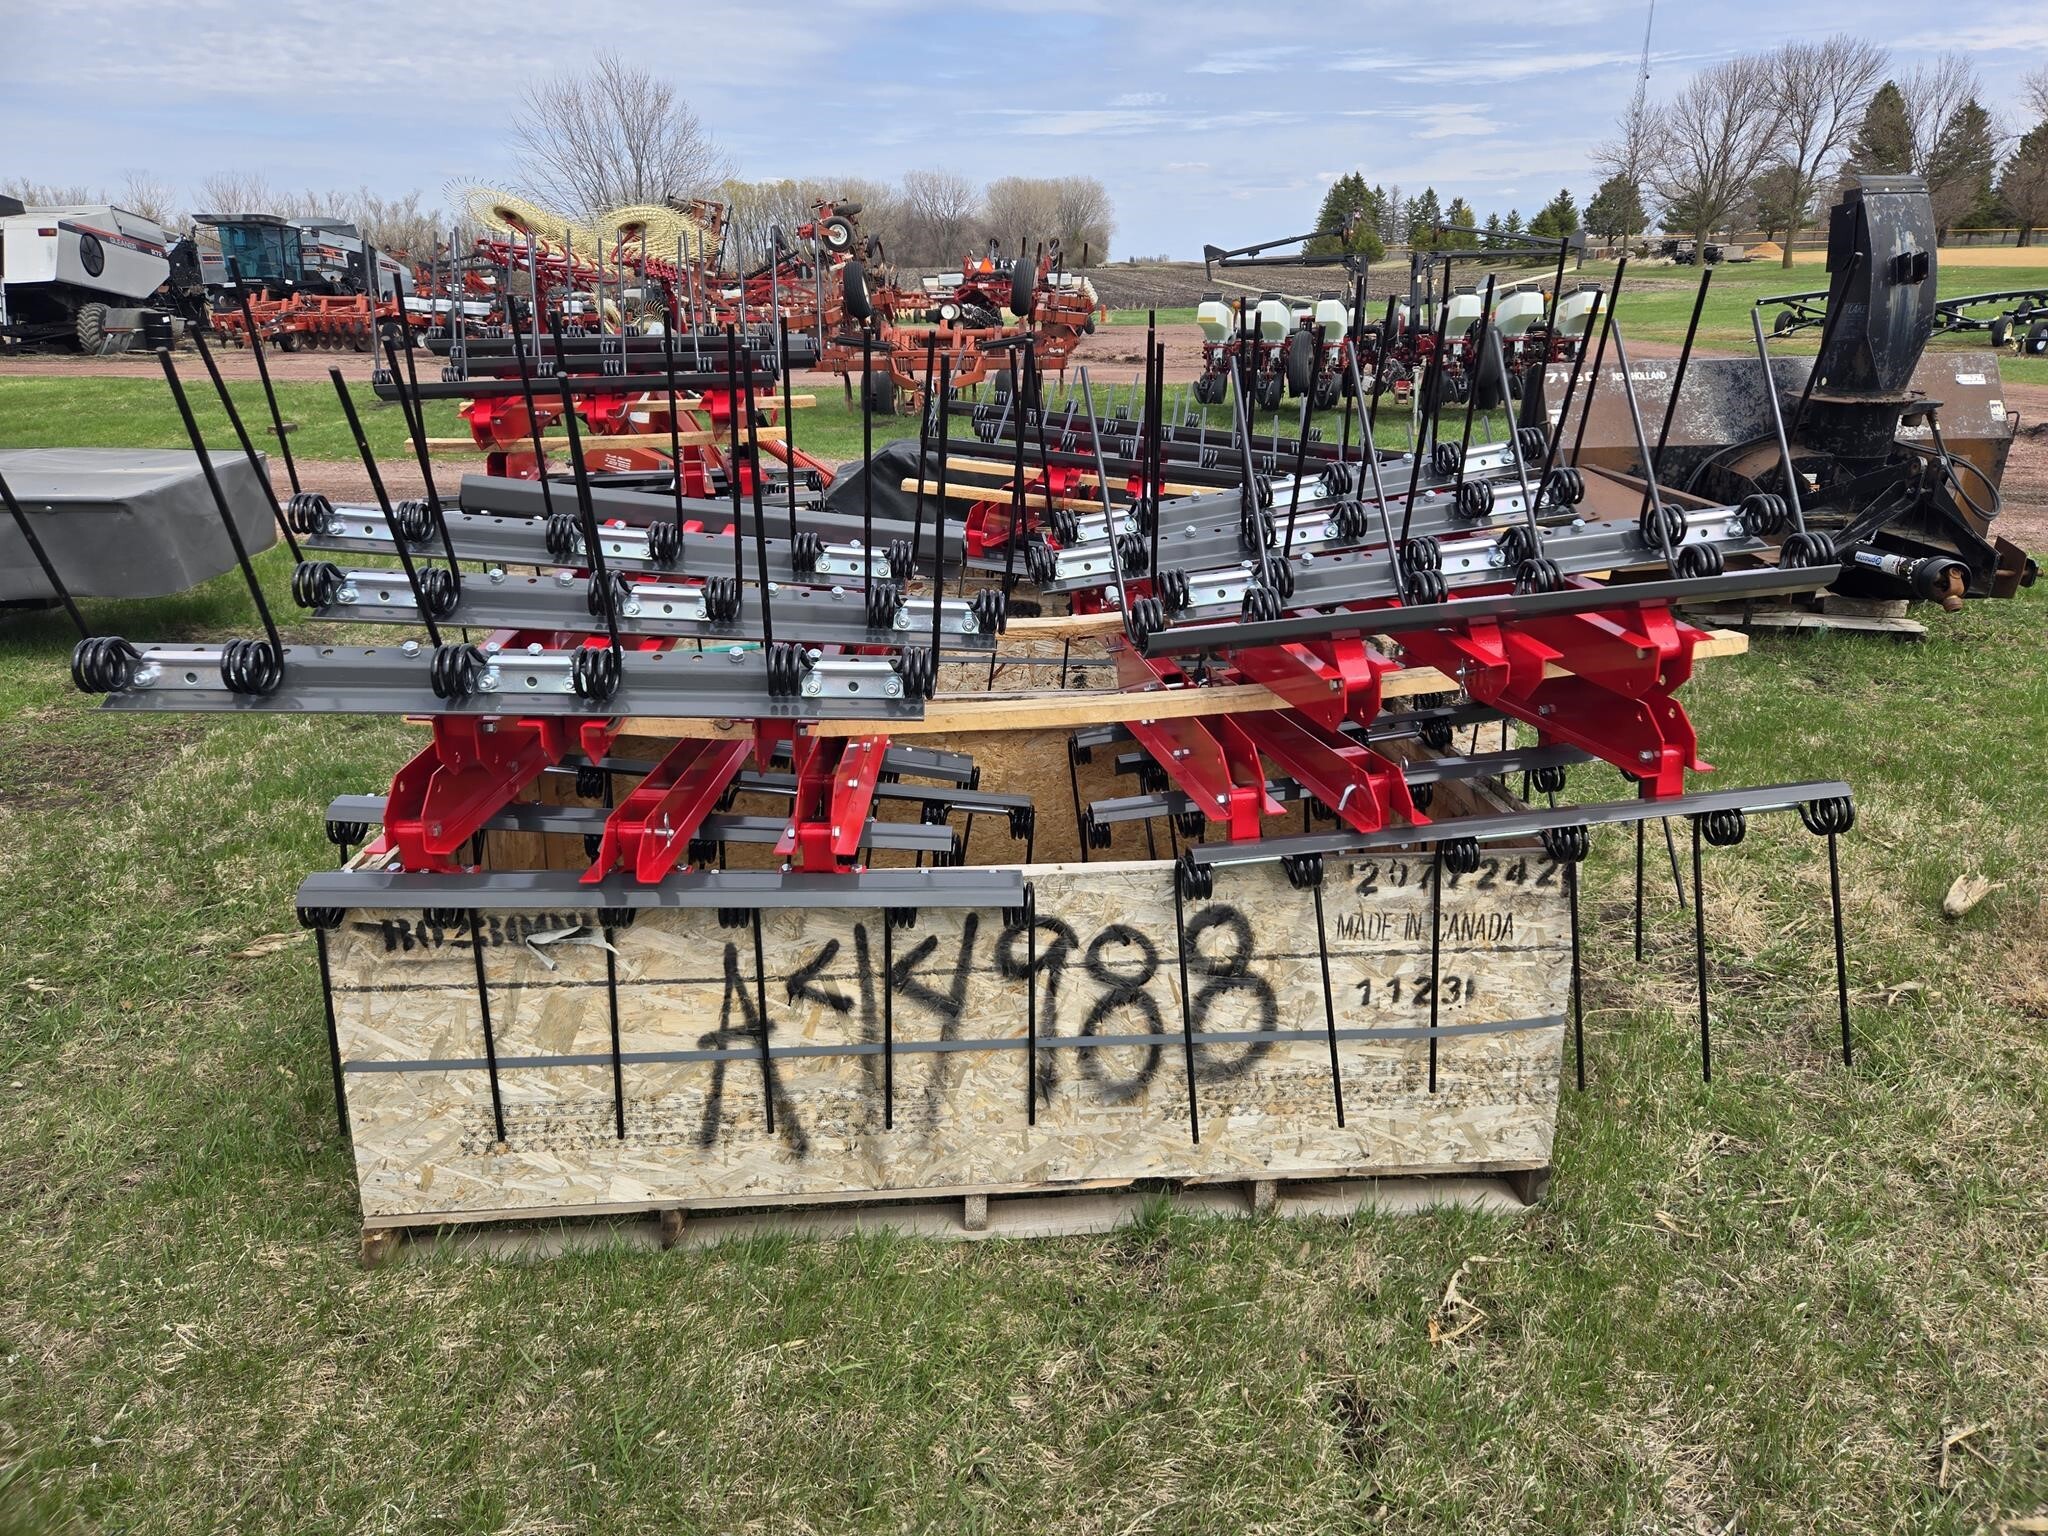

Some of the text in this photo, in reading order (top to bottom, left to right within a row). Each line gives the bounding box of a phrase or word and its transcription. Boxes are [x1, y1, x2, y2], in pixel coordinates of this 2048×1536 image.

[1631, 371, 1667, 381] HOLLAND
[1337, 911, 1514, 942] MADE IN CANADA
